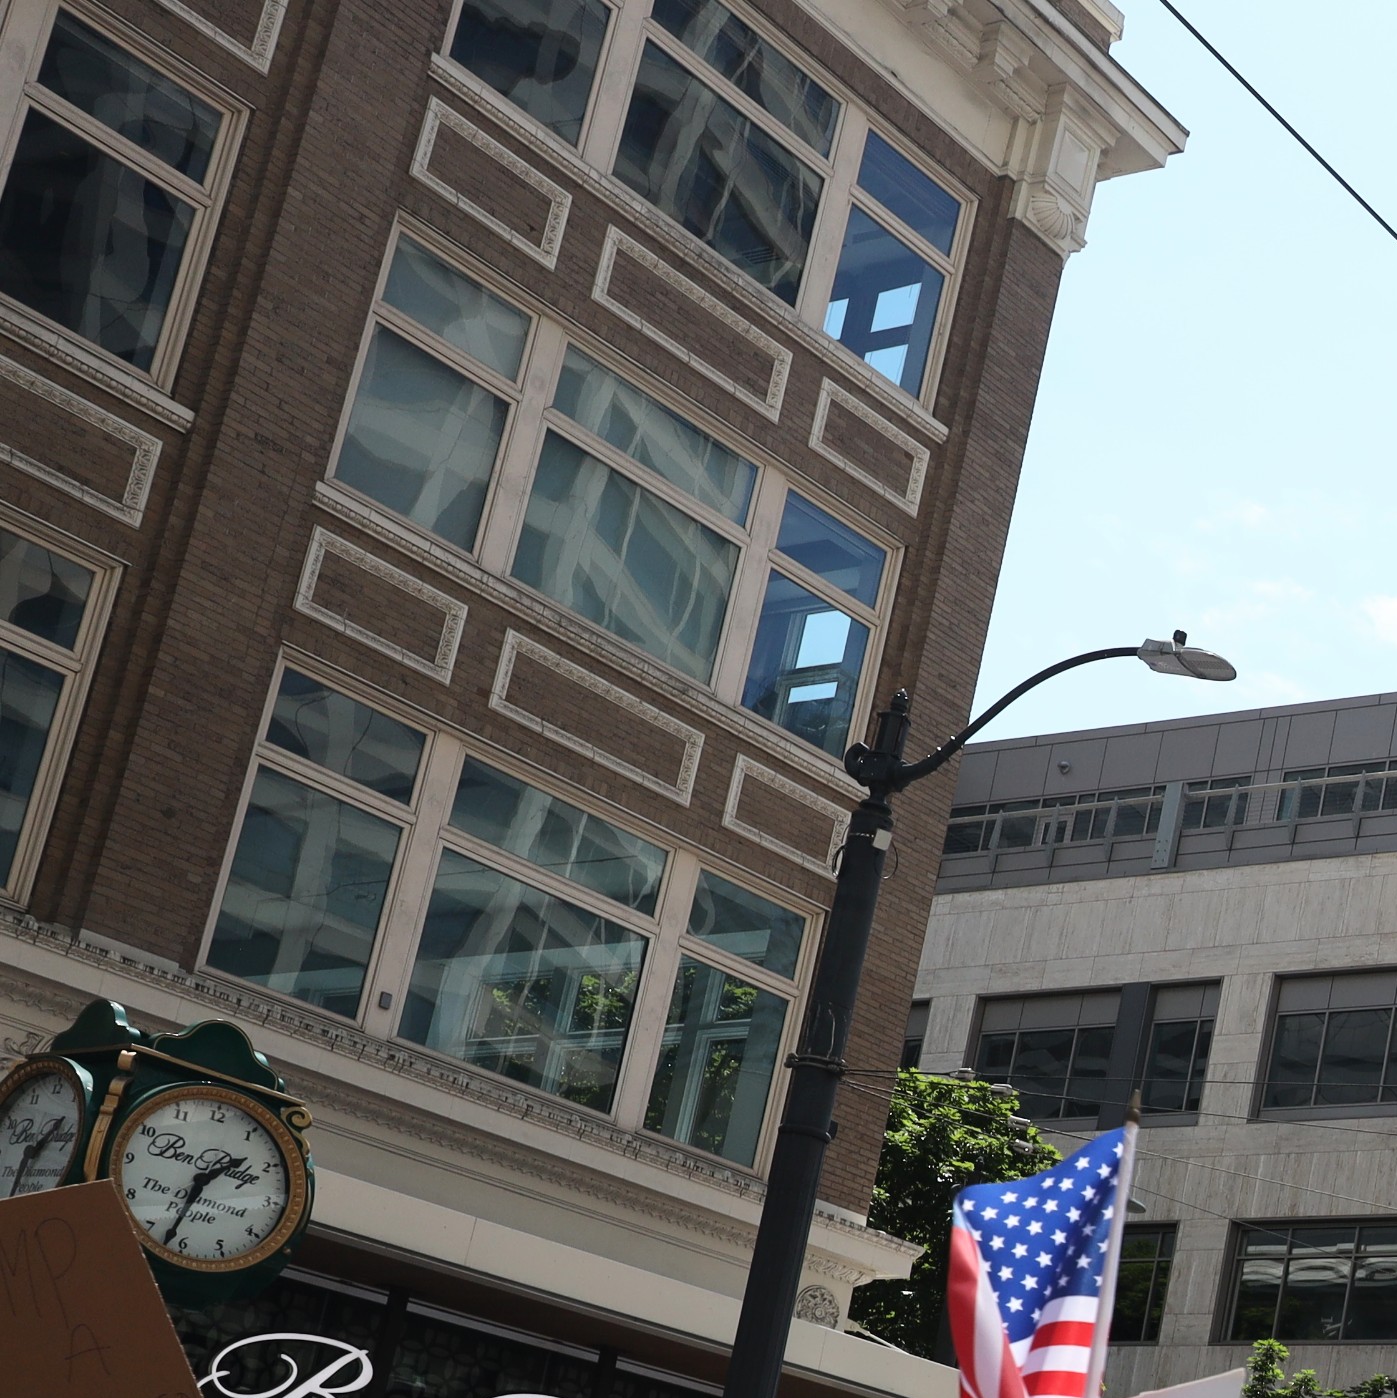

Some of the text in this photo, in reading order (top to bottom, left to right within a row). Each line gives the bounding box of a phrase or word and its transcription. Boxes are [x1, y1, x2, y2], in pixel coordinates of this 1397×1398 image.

[173, 1109, 189, 1123] 11
[209, 1110, 226, 1124] 12
[139, 1124, 156, 1138] 10
[243, 1130, 252, 1141] 1
[147, 1132, 194, 1165] Ben
[125, 1153, 135, 1165] 9
[262, 1161, 272, 1173] 2
[125, 1187, 136, 1200] 8
[142, 1176, 248, 1218] The Dmond
[263, 1195, 272, 1208] 3
[145, 1220, 156, 1232] 7
[244, 1225, 255, 1237] 4
[178, 1236, 188, 1250] 6
[214, 1238, 224, 1251] 5
